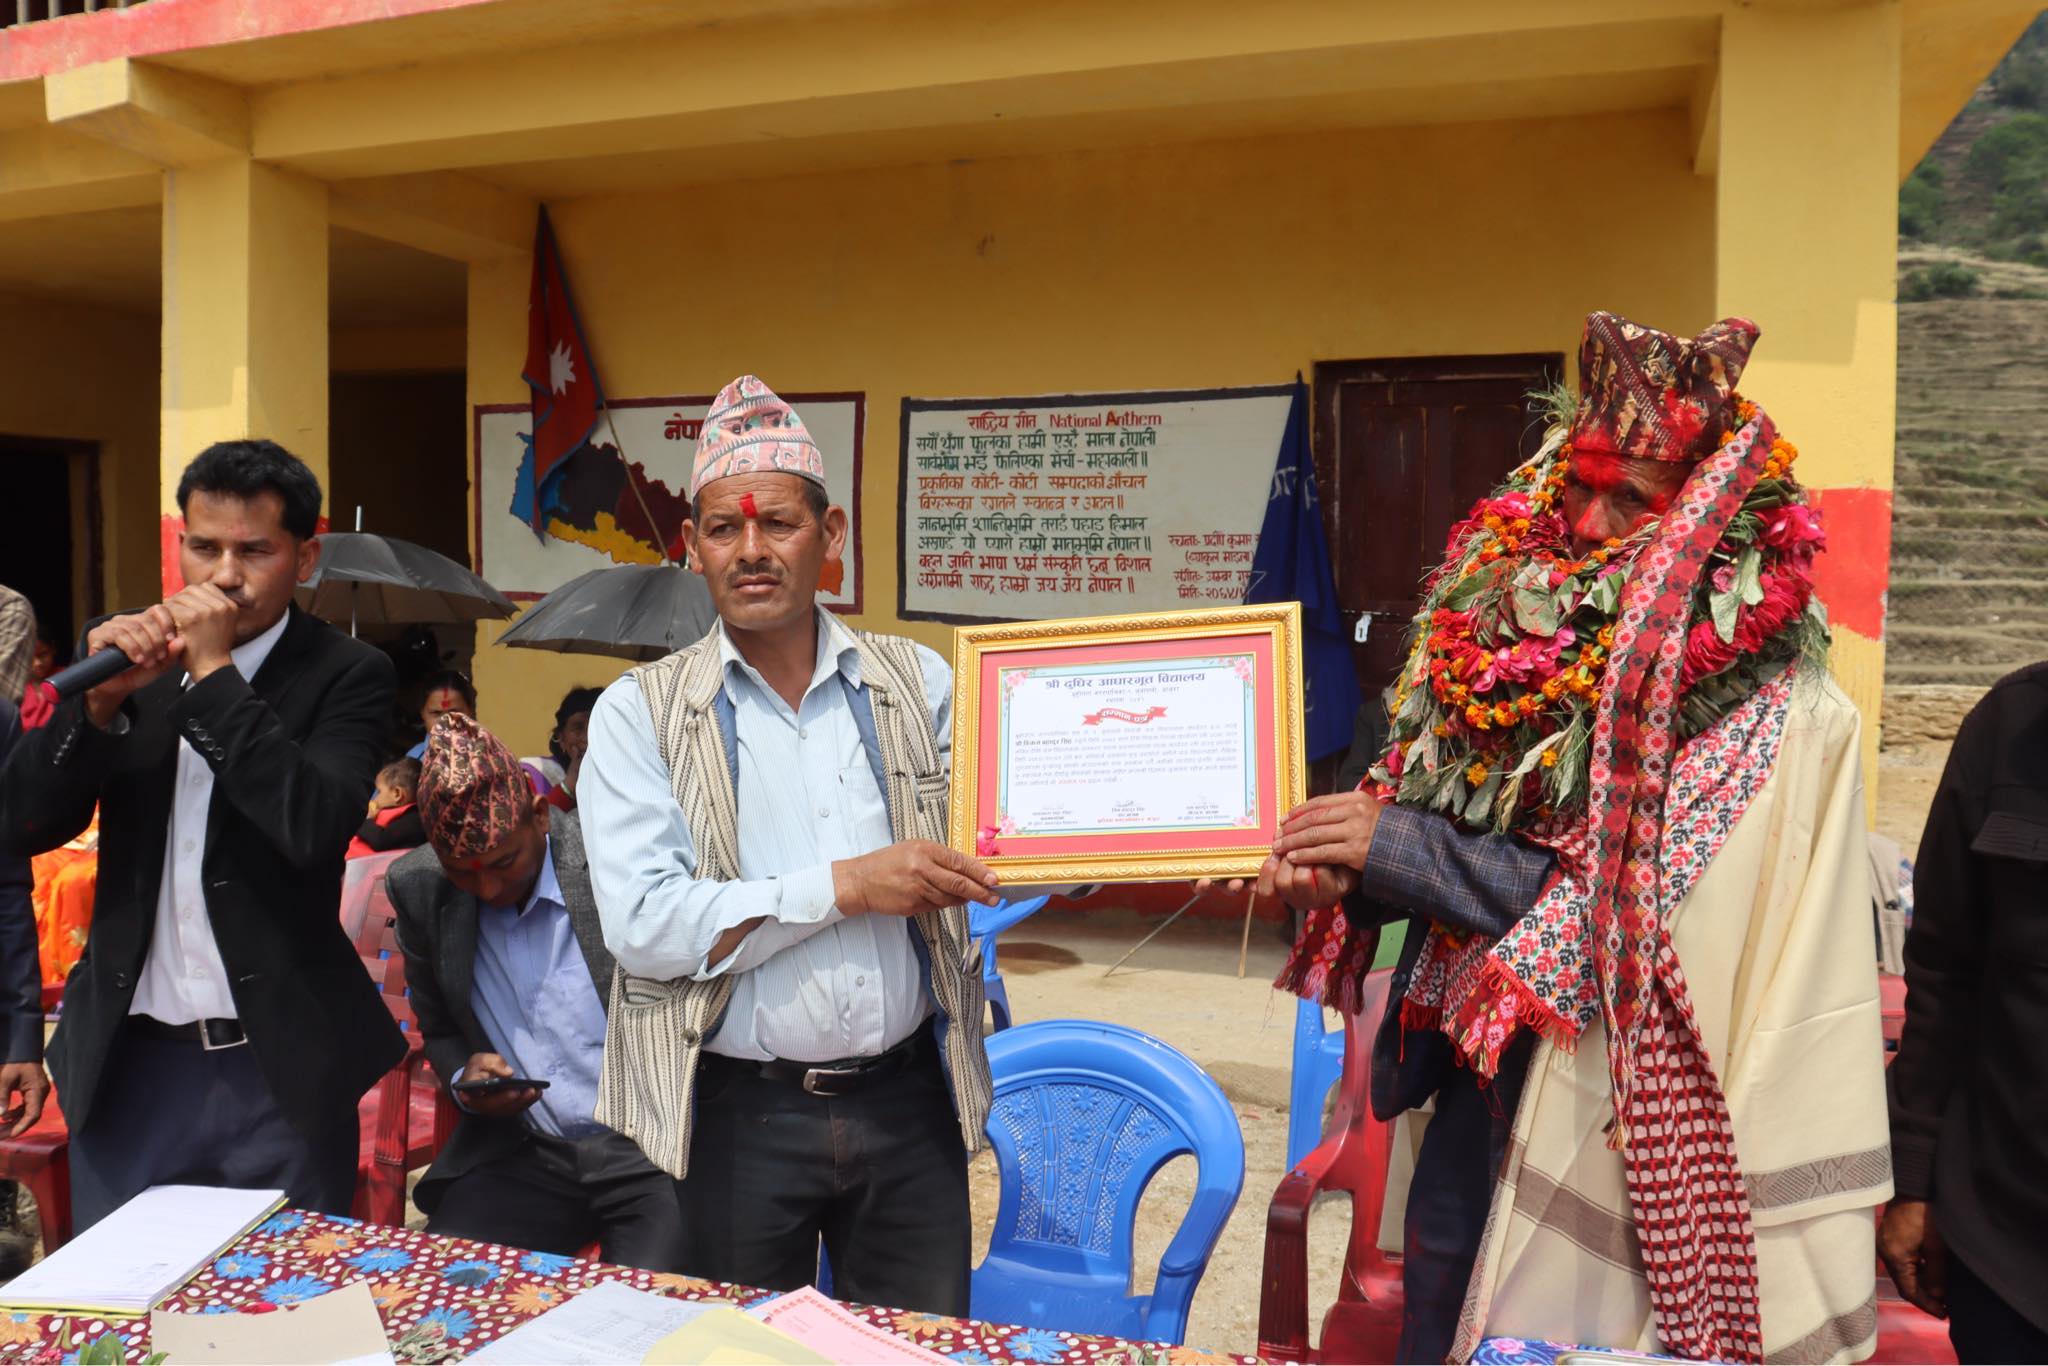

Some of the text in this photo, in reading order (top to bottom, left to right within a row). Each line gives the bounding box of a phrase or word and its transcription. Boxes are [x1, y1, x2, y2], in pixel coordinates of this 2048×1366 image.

[1013, 411, 1038, 429] गीत
[1049, 413, 1102, 428] National
[1017, 429, 1047, 448] हामी
[1085, 432, 1116, 447] माला
[1119, 427, 1156, 447] नेपाली
[1071, 496, 1080, 508] र
[1108, 513, 1148, 533] हिमाल
[961, 531, 976, 549] यो
[984, 533, 1013, 550] प्यारो
[1019, 532, 1047, 552] हाम्रो
[1107, 533, 1141, 551] नेपाल
[1227, 534, 1252, 548] कुमार
[947, 551, 975, 568] जाति
[979, 555, 1008, 570] भाषा
[1000, 574, 1030, 595] हाम्रो
[1035, 577, 1058, 592] जय
[1062, 576, 1083, 592] जय
[1088, 573, 1122, 593] नेपाल
[1157, 671, 1206, 685] विद्यालय
